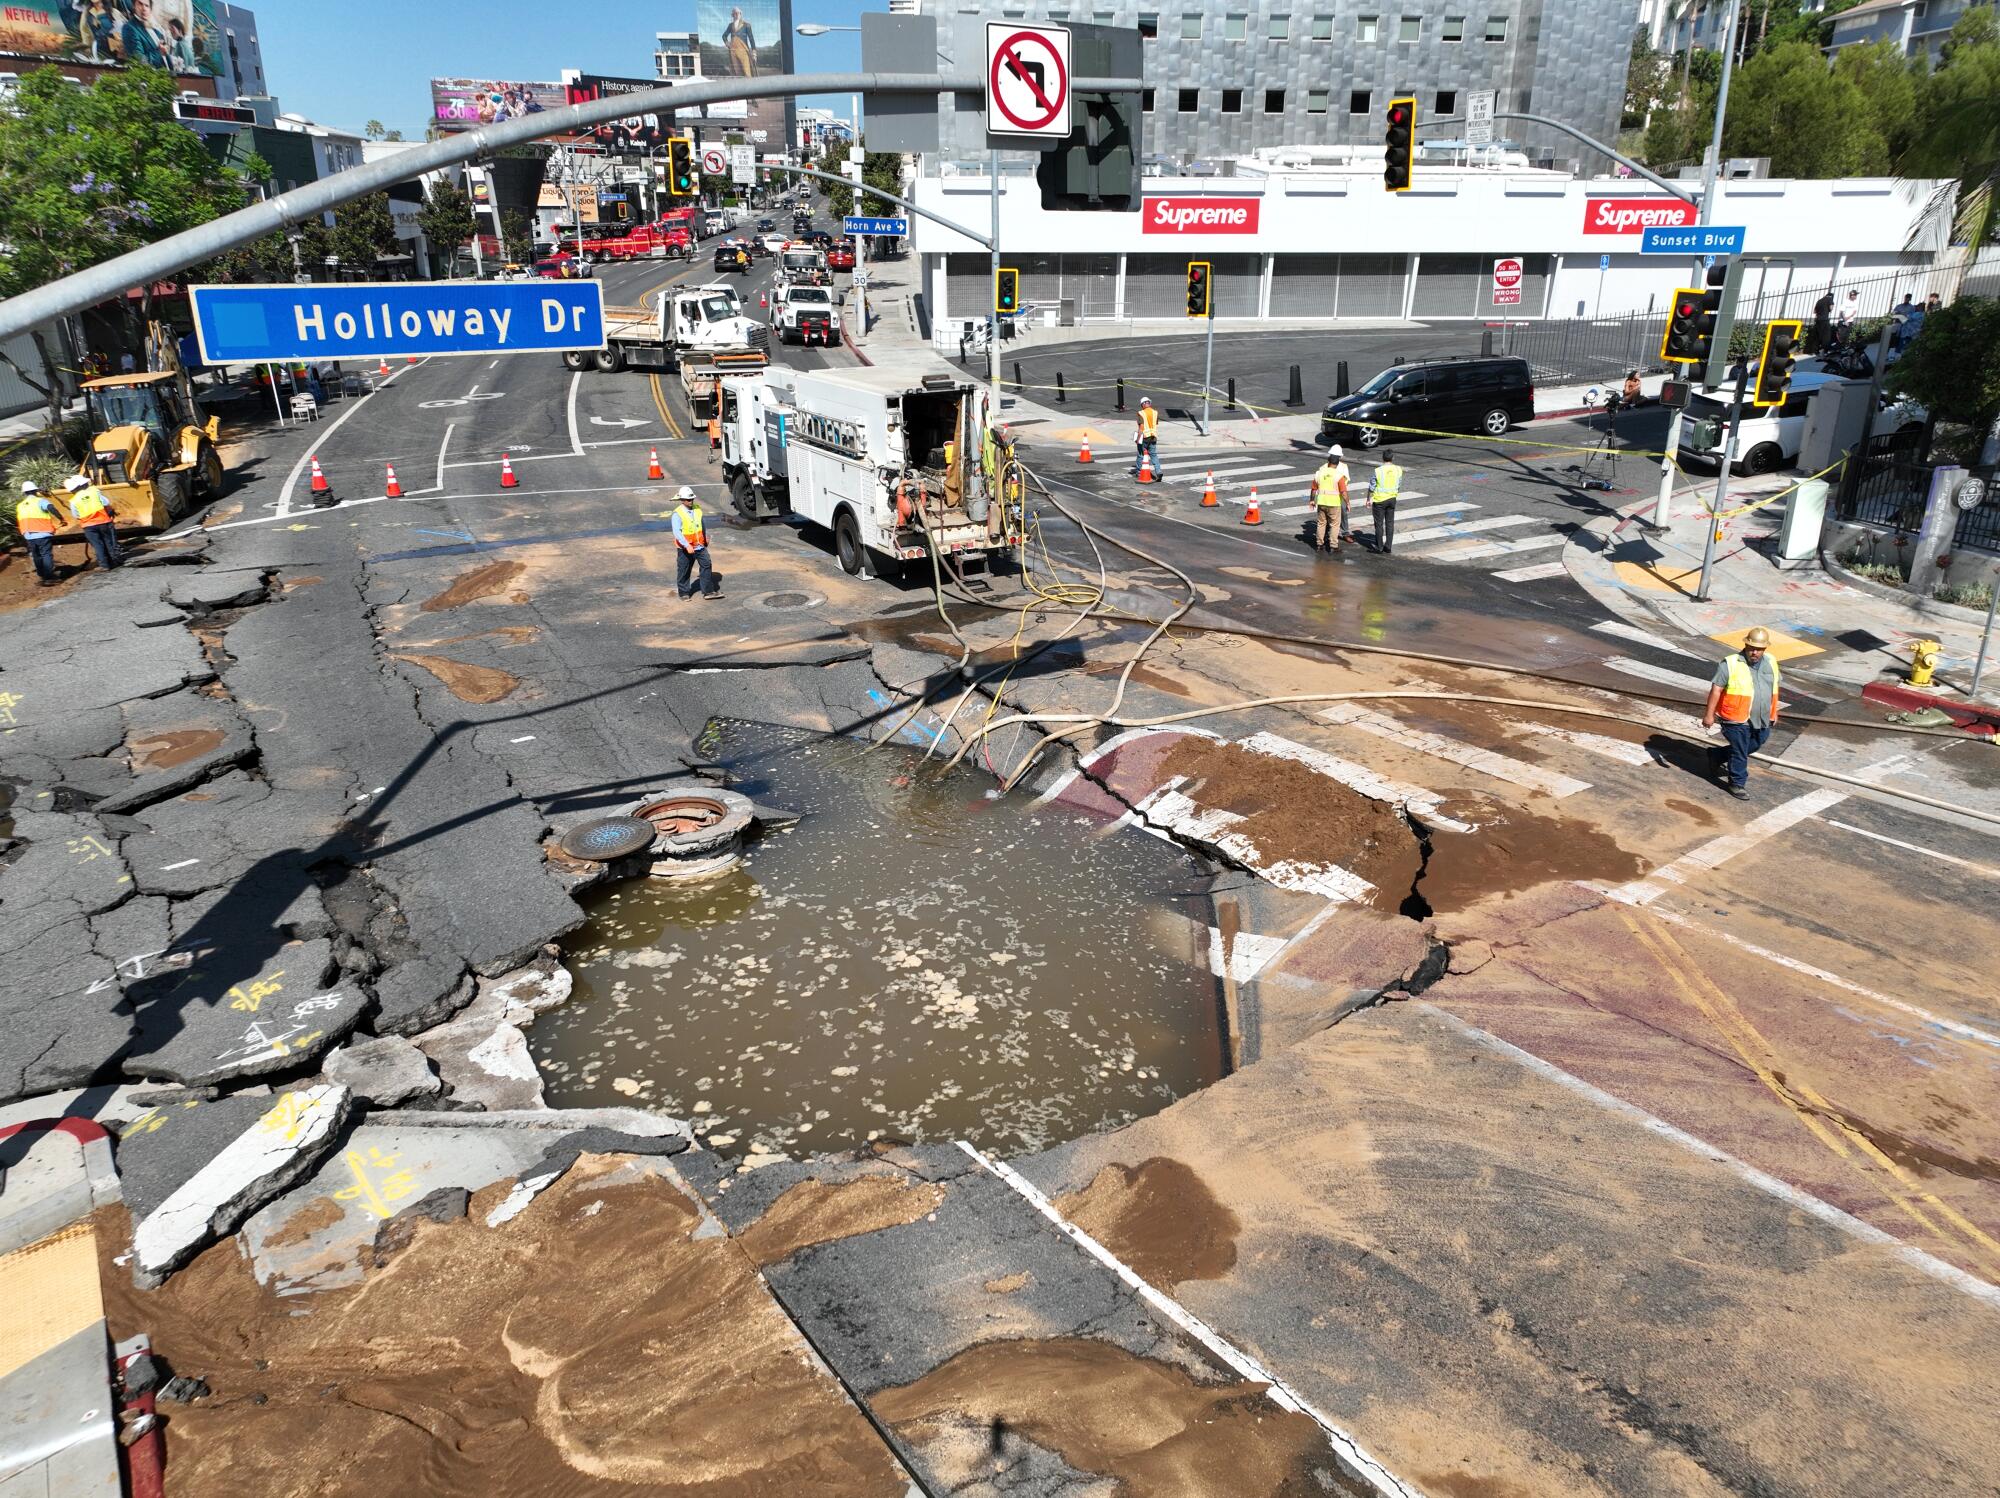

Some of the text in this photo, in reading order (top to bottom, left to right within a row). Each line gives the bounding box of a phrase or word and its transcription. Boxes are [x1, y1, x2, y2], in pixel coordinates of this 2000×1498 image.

[4, 6, 51, 26] NETFLIX
[601, 80, 631, 93] History,
[197, 106, 238, 121] NETFLIX
[1473, 112, 1486, 120] BLOCK
[1467, 119, 1491, 128] INTERSECTION
[750, 129, 768, 138] HBO
[821, 128, 846, 137] CELINE
[1154, 200, 1248, 231] Supreme
[1595, 202, 1686, 232] Supreme
[845, 220, 892, 232] Horn Ave
[1651, 234, 1735, 246] Sunset Blvd
[854, 277, 866, 285] 30
[293, 298, 586, 344] Holloway Dr
